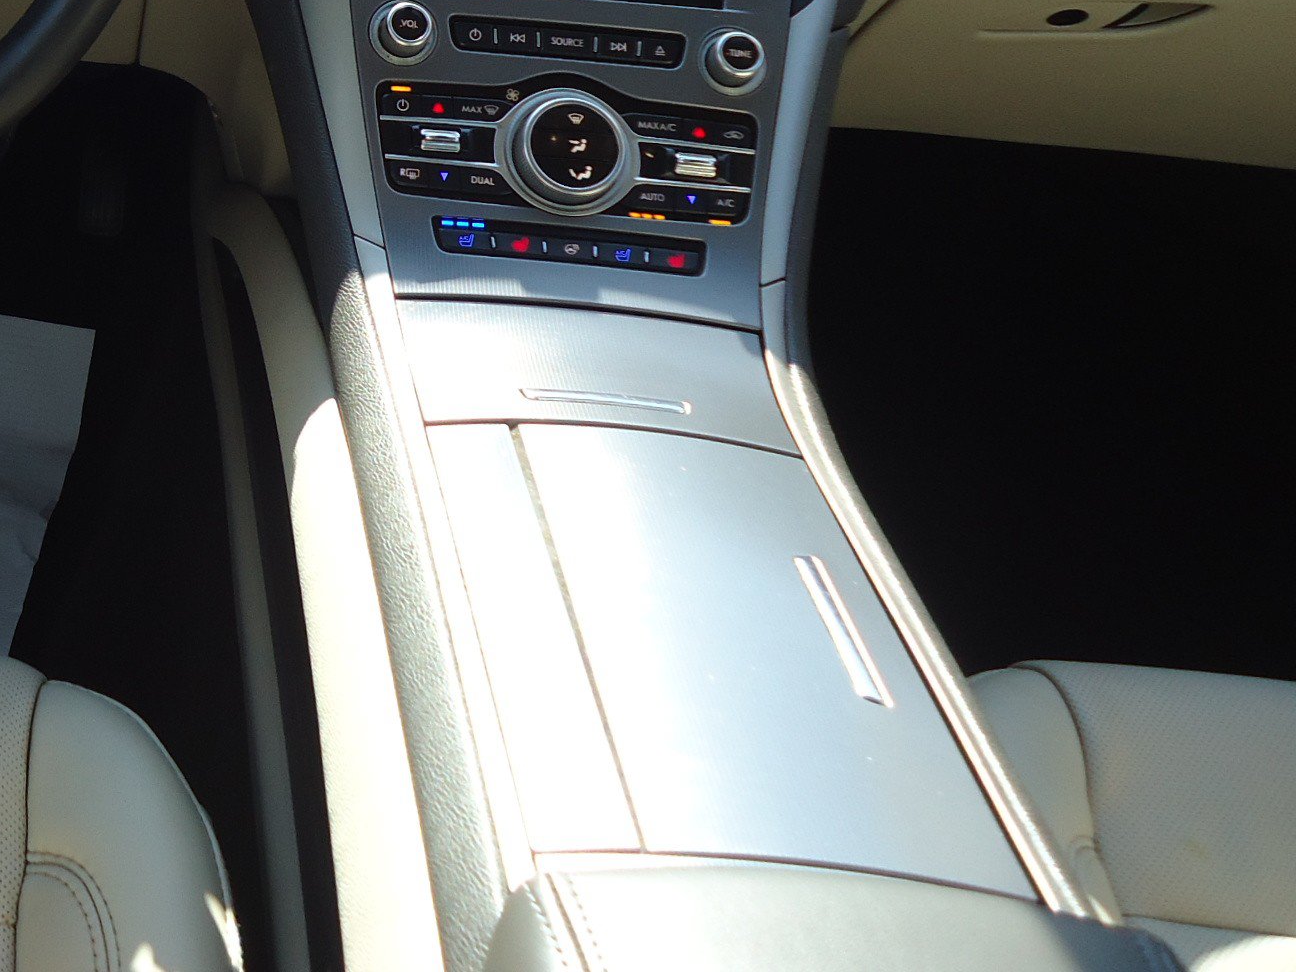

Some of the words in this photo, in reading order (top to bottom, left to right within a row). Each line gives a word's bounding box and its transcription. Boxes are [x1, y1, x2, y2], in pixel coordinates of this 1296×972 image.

[401, 17, 419, 30] VOL
[551, 37, 584, 48] SOURCE
[728, 48, 753, 59] TUNE
[462, 106, 483, 114] MAX
[471, 175, 496, 186] DUAL
[640, 192, 665, 202] AUTO
[717, 199, 735, 208] A/C
